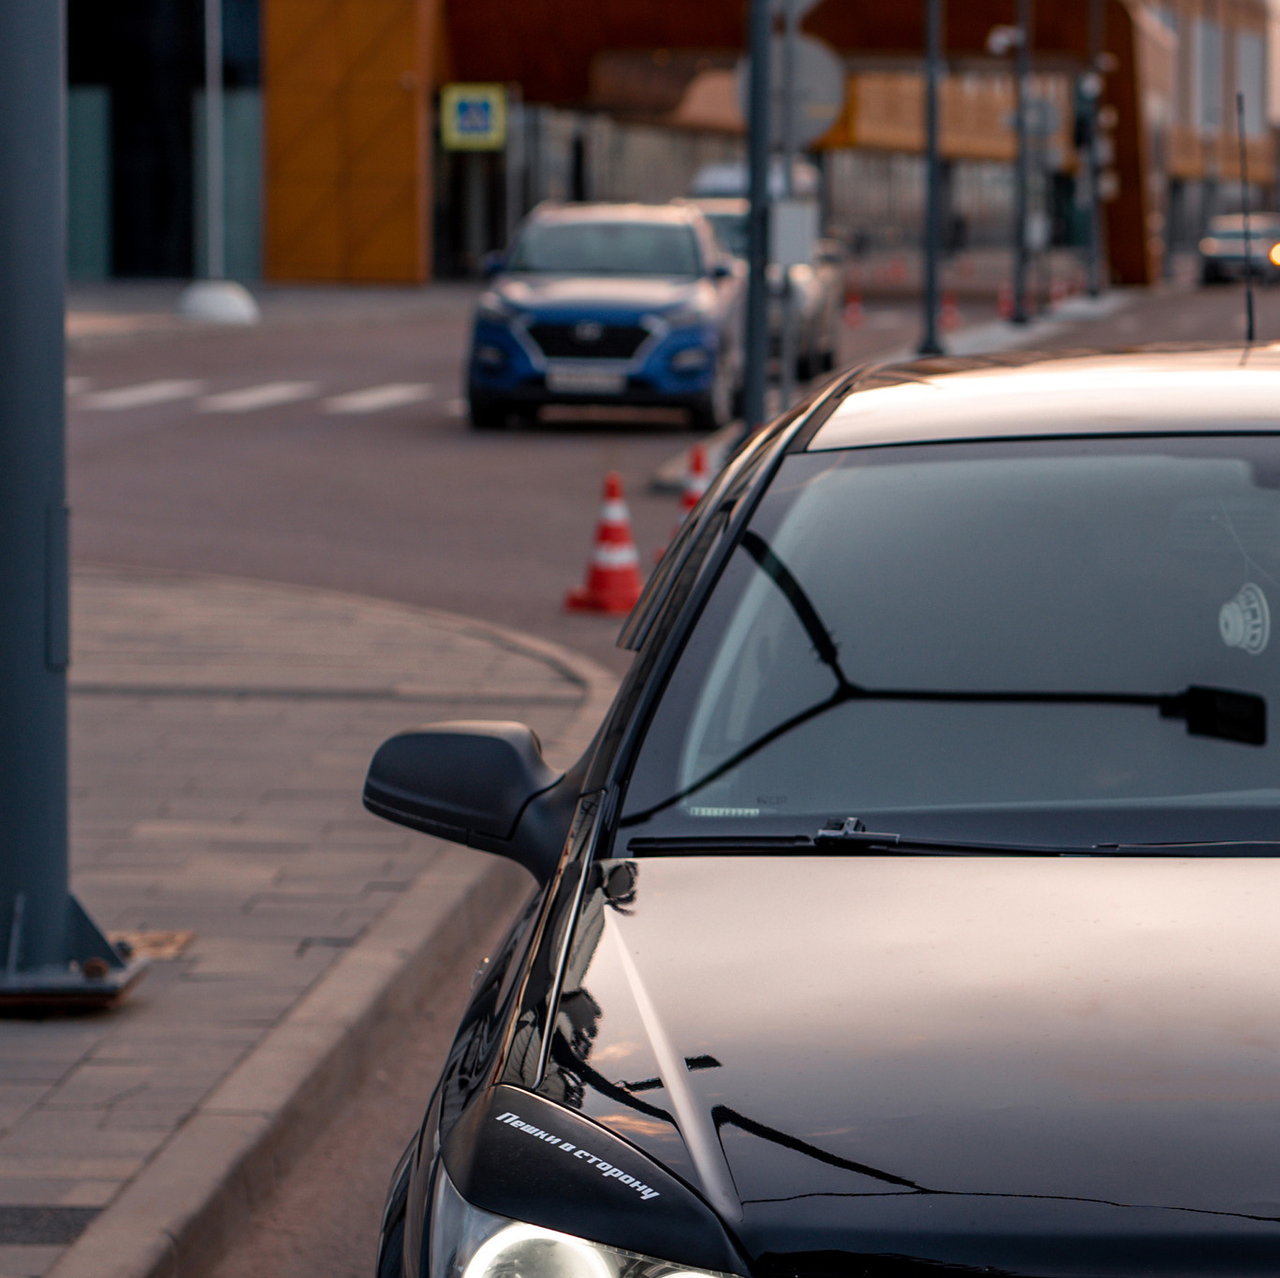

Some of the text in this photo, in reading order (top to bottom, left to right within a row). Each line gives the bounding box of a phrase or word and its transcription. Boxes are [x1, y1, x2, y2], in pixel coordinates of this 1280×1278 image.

[495, 1112, 660, 1200] Пешки в сторону
